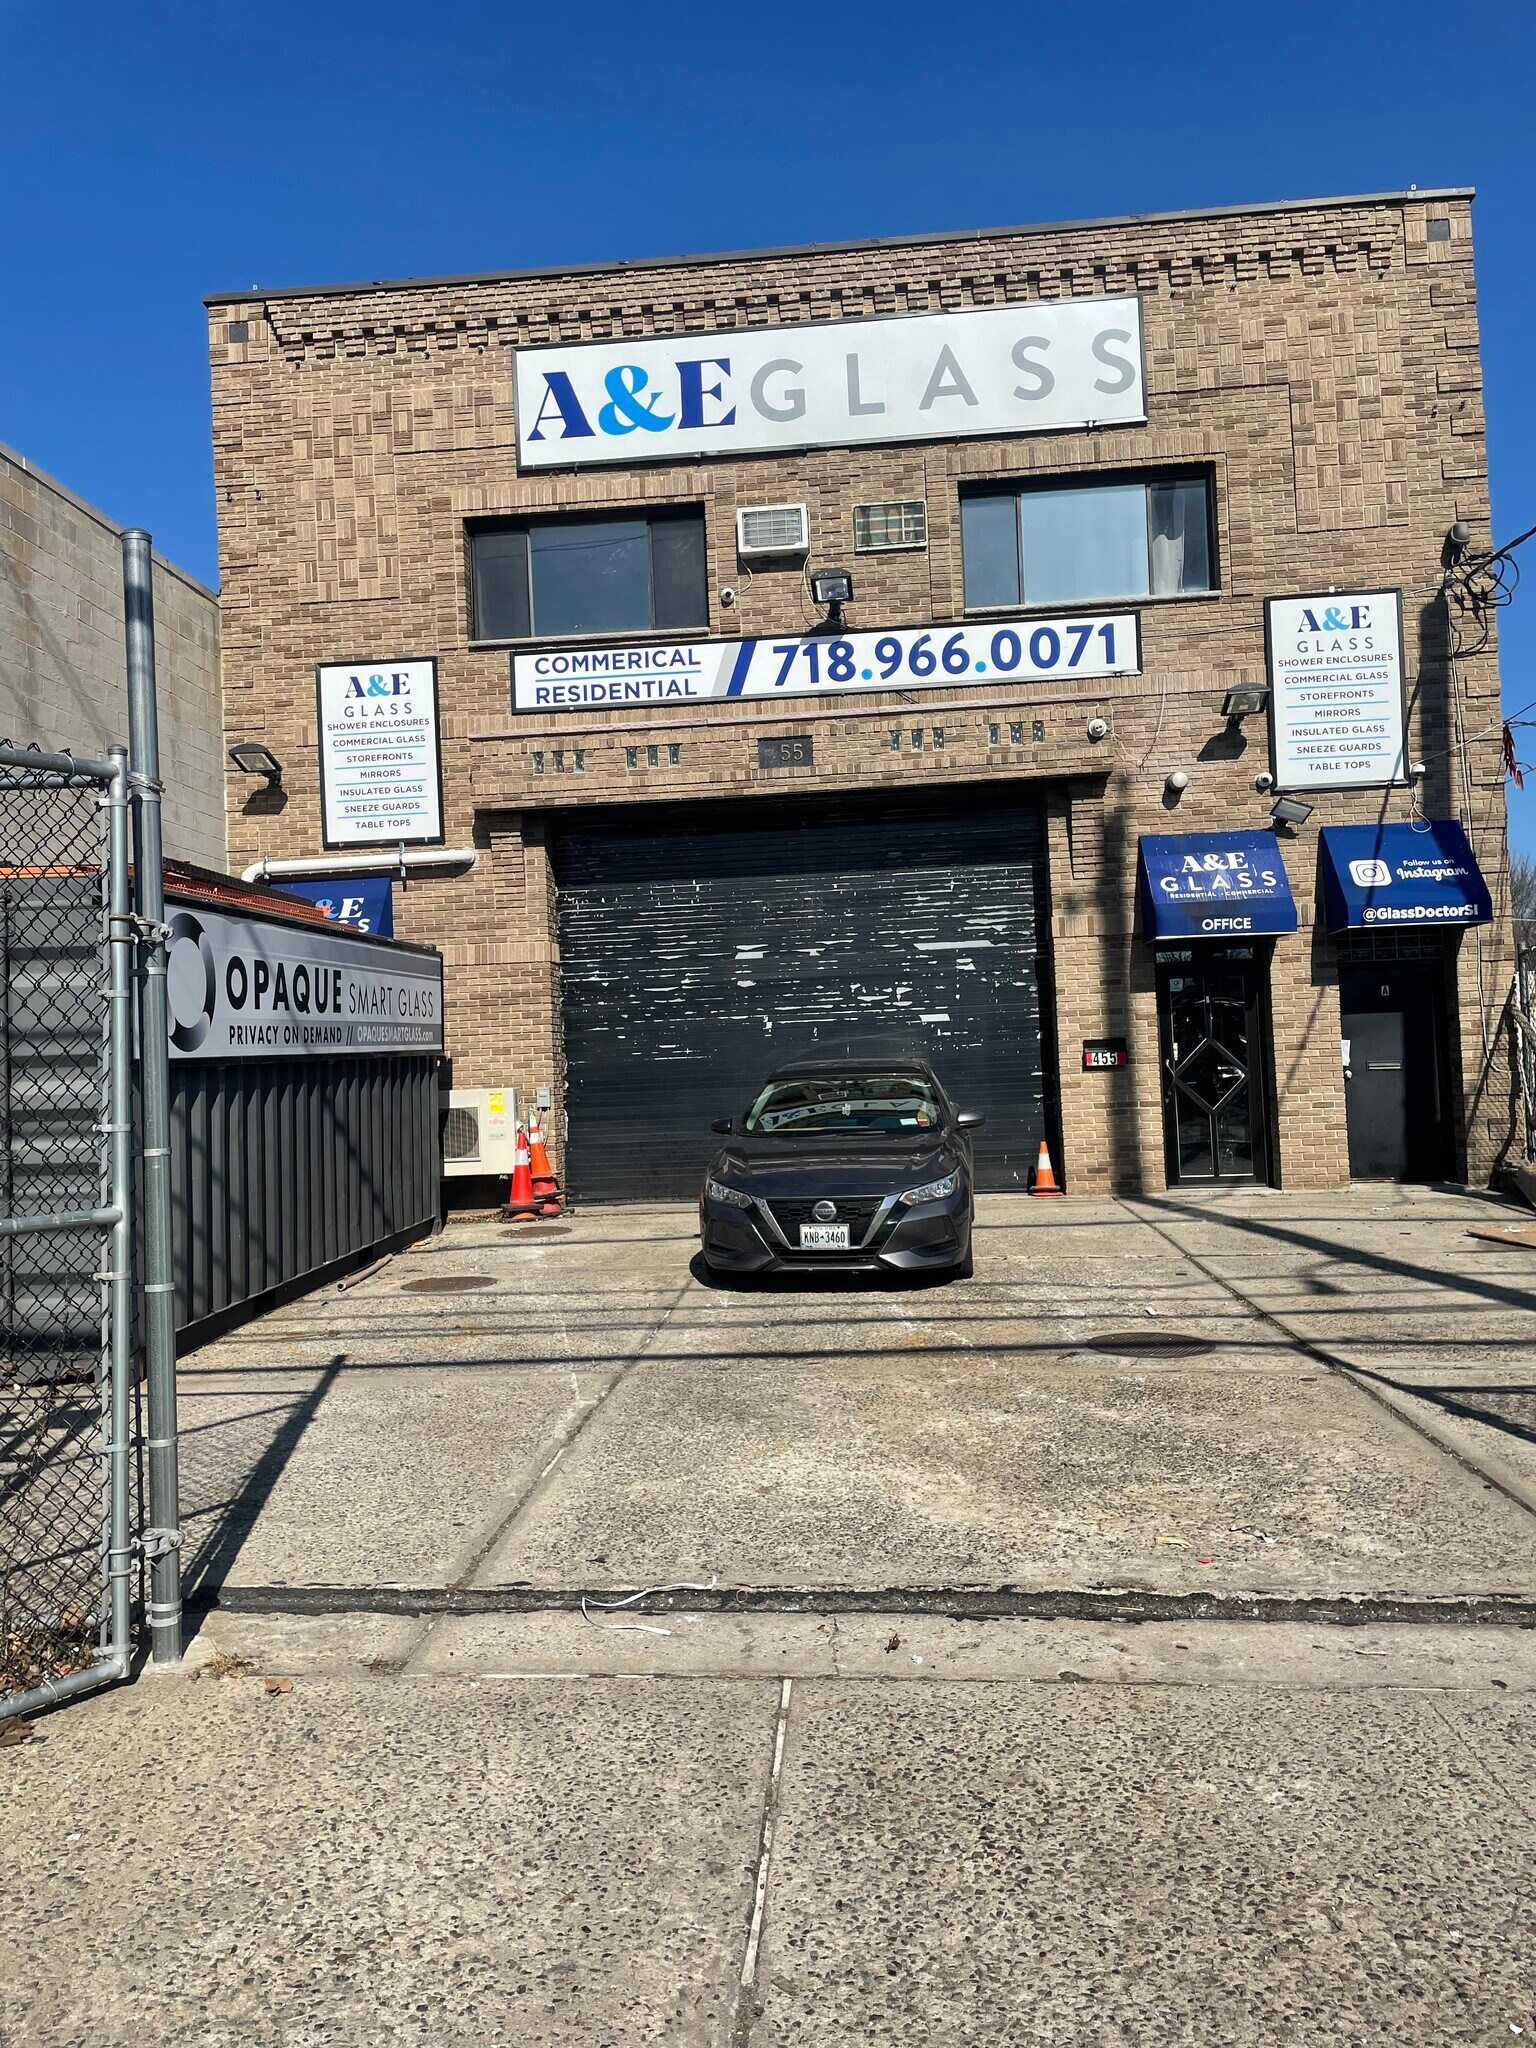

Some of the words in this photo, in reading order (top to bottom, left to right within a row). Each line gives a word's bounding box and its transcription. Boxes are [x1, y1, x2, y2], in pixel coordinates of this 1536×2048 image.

[527, 357, 737, 441] A&E
[750, 329, 1136, 423] GLASS
[1297, 605, 1372, 633] A&E
[1297, 636, 1374, 653] GLASS
[534, 648, 701, 674] COMMERICAL
[772, 622, 1116, 686] 718.966.0071
[1278, 657, 1323, 667] SHOWER
[1326, 653, 1394, 665] ENCLOSURES
[1284, 673, 1353, 684] COMMERCIAL
[1355, 671, 1389, 681] GLASS
[344, 672, 411, 699] A&E
[535, 678, 698, 705] RESIDENTIAL
[1299, 690, 1375, 701] STOREFRONTS
[344, 702, 413, 718] GLASS
[1314, 708, 1361, 718] MIRRORS
[327, 721, 367, 731] SHOWER
[370, 718, 430, 729] ENCLOSURES
[1292, 726, 1349, 737] INSULATED
[1351, 724, 1385, 734] GLASS
[333, 736, 394, 747] COMMERCIAL
[396, 735, 426, 744] GLASS
[1296, 744, 1336, 754] SNEEZE
[1339, 742, 1382, 752] GUARDS
[346, 752, 413, 763] STOREFRONTS
[781, 743, 803, 761] 55
[1309, 762, 1341, 771] TABLE
[1344, 760, 1371, 770] TOPS
[360, 769, 402, 779] MIRRORS
[340, 787, 391, 797] INSULATED
[394, 785, 423, 794] GLASS
[344, 804, 380, 813] SNEEZE
[382, 802, 421, 811] GUARDS
[355, 820, 385, 829] TABLE
[387, 819, 411, 828] TOPS
[1181, 851, 1249, 873] A&E
[1402, 859, 1430, 867] Follow
[1396, 866, 1469, 881] Instagram
[1160, 870, 1277, 892] GLASS
[1362, 904, 1479, 922] @GlassDoctorSI
[1201, 917, 1252, 931] OFFICE
[225, 955, 342, 1015] OPAQUE
[348, 983, 393, 1016] SMART
[398, 988, 434, 1018] GLASS
[229, 1025, 279, 1045] PRIVACY
[283, 1026, 299, 1044] ON
[303, 1026, 342, 1044] DEMAND
[357, 1025, 434, 1043] OPAQUESMARTGLASS.com
[1092, 1051, 1117, 1065] 455
